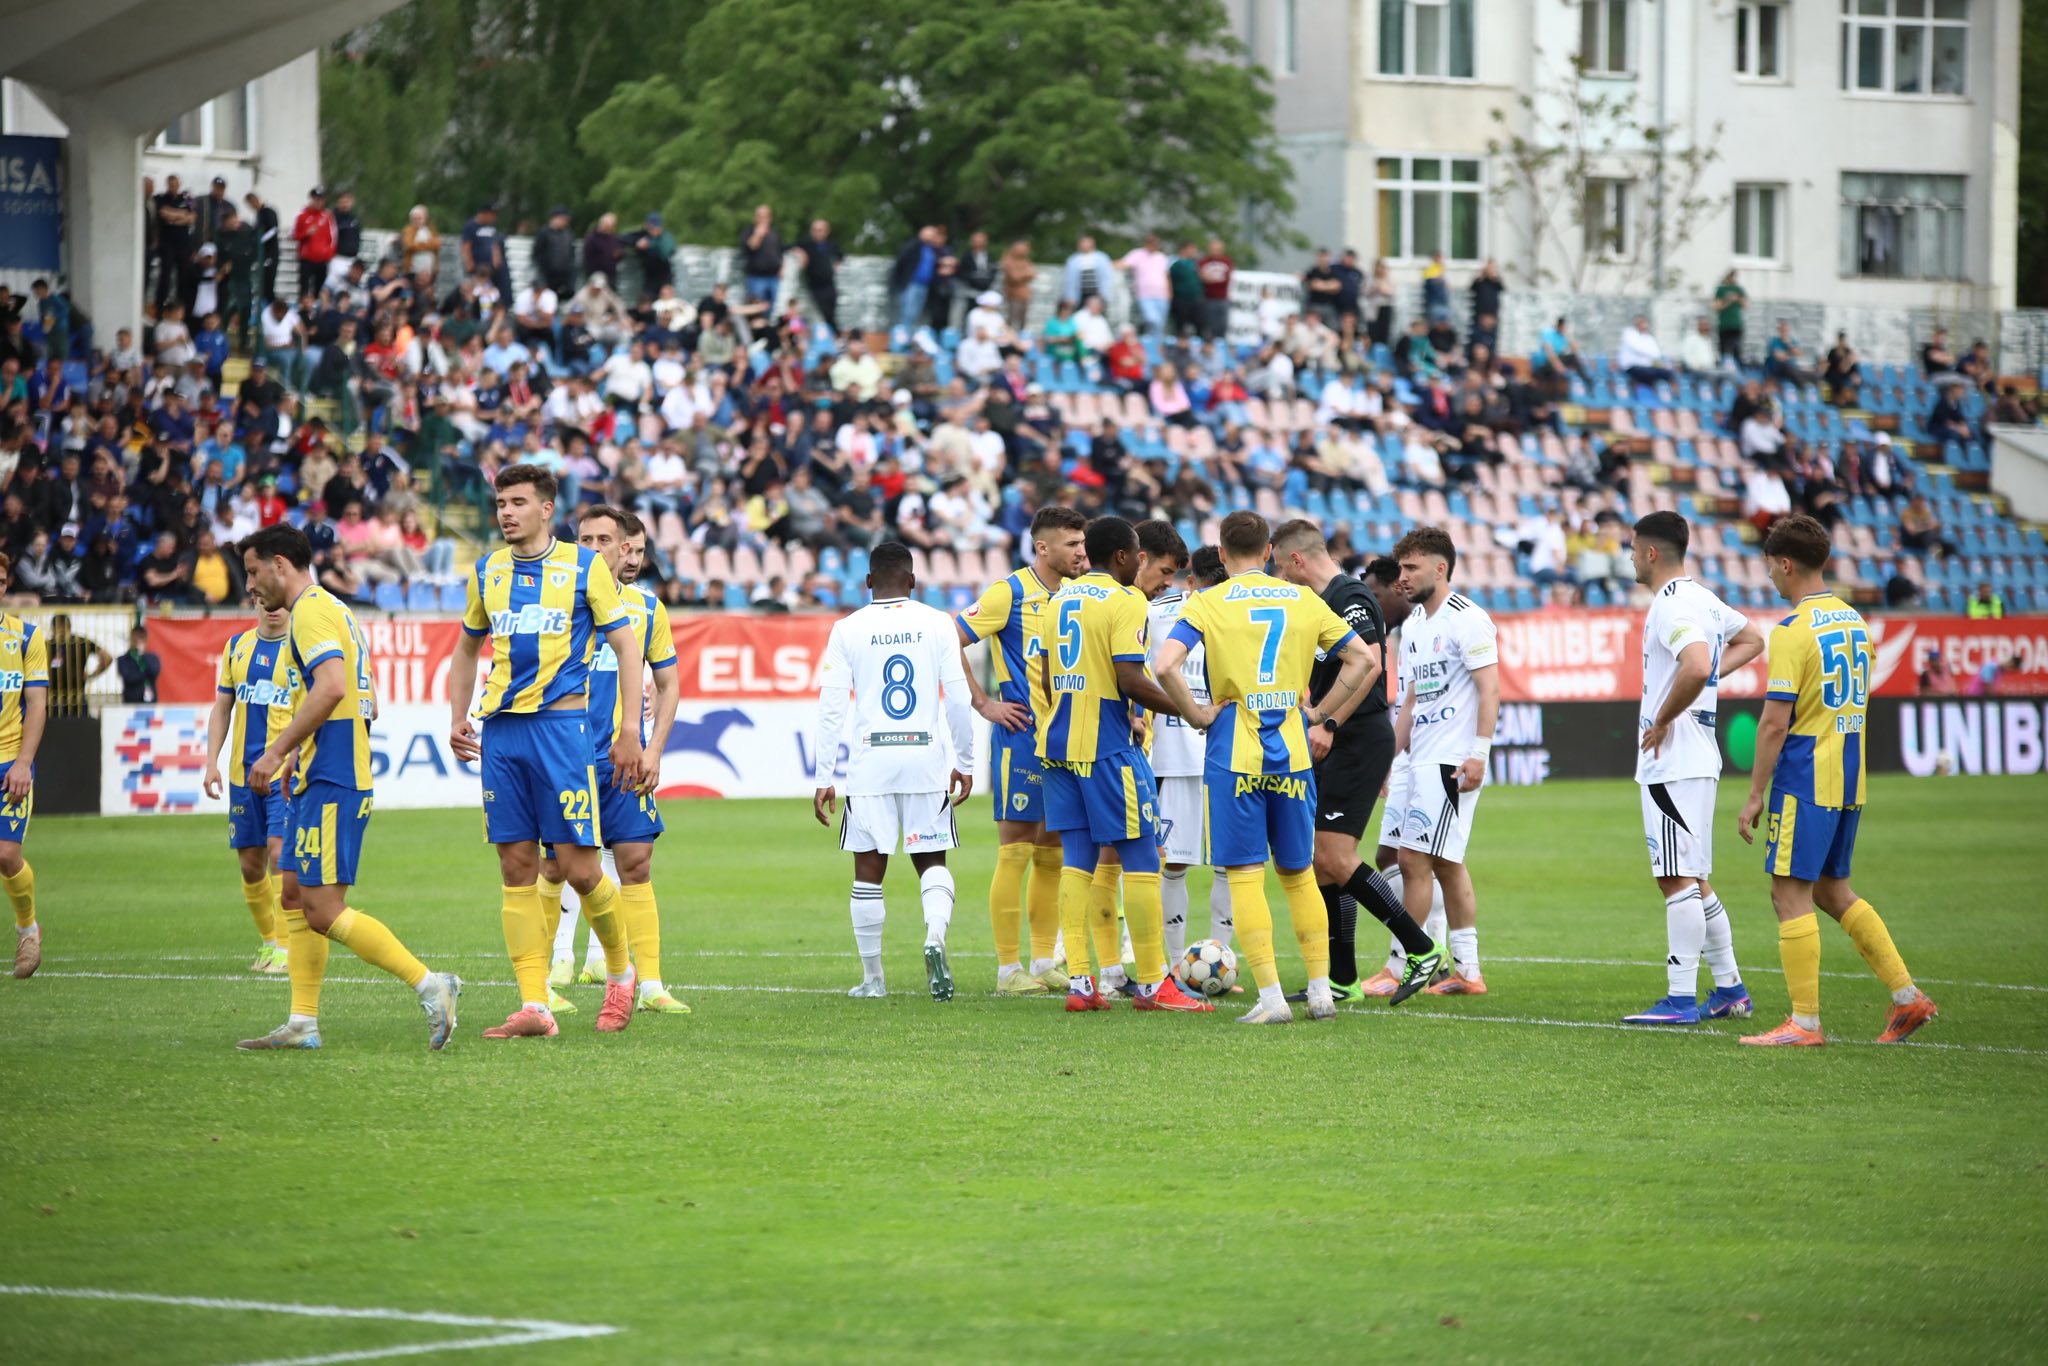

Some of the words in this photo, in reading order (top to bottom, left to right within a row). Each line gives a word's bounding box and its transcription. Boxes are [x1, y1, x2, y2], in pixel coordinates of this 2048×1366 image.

[1226, 584, 1249, 600] La
[1252, 587, 1298, 599] cocos
[491, 604, 567, 636] MrBit
[1812, 609, 1831, 627] La
[870, 632, 923, 645] ALDAIR.F
[1059, 599, 1082, 670] 5
[1250, 609, 1286, 683] 7
[1499, 617, 1631, 668] UNIBET
[1818, 629, 1869, 709] 55
[882, 654, 917, 720] 8
[1247, 692, 1296, 710] GROZAV
[1901, 703, 2048, 777] UNIB
[560, 789, 590, 820] 22
[295, 827, 321, 858] 24
